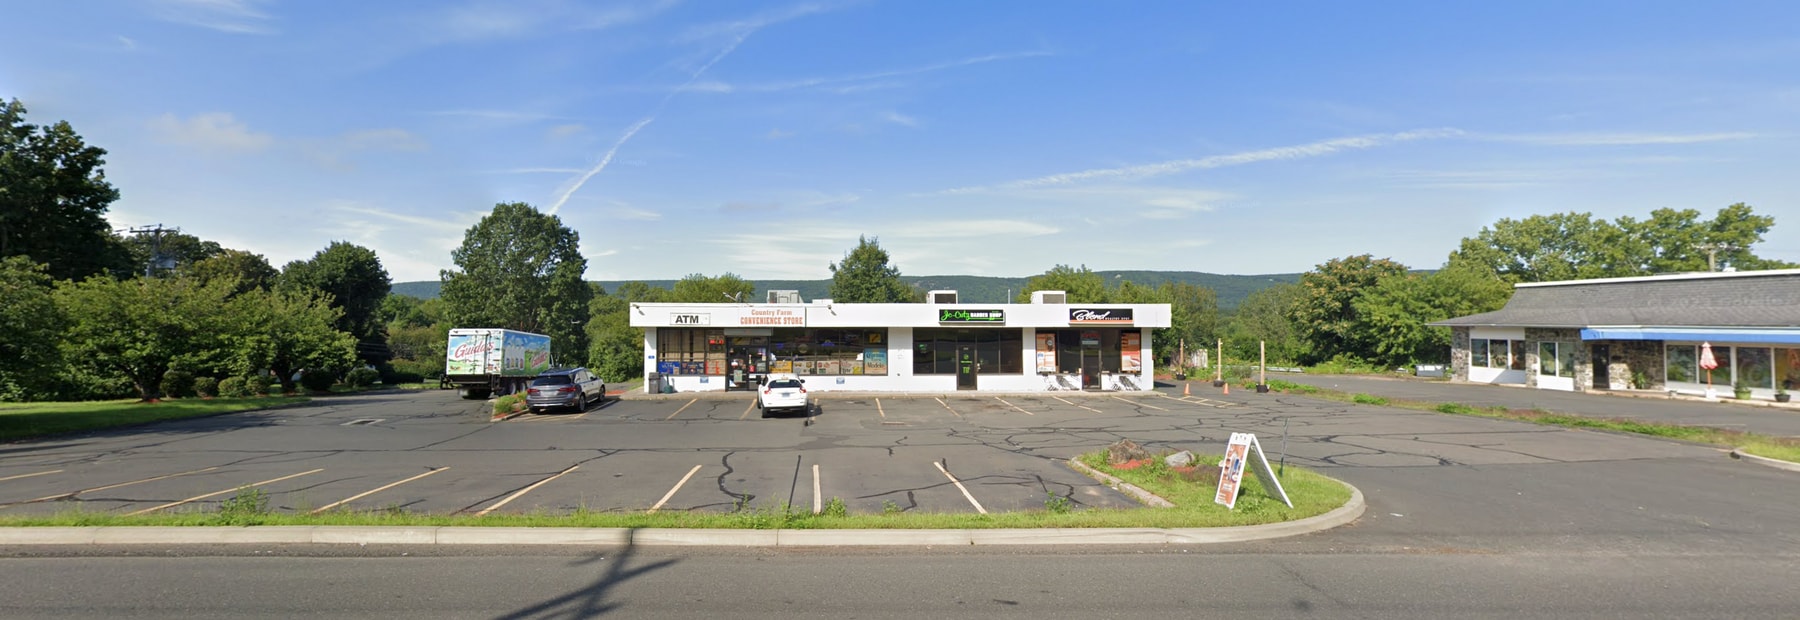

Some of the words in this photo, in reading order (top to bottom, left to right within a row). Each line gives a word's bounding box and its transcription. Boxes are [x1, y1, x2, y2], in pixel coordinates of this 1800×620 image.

[675, 315, 699, 324] ATM
[1072, 309, 1111, 321] Blend
[740, 316, 782, 325] CONVENIENCE
[783, 316, 803, 325] STORE
